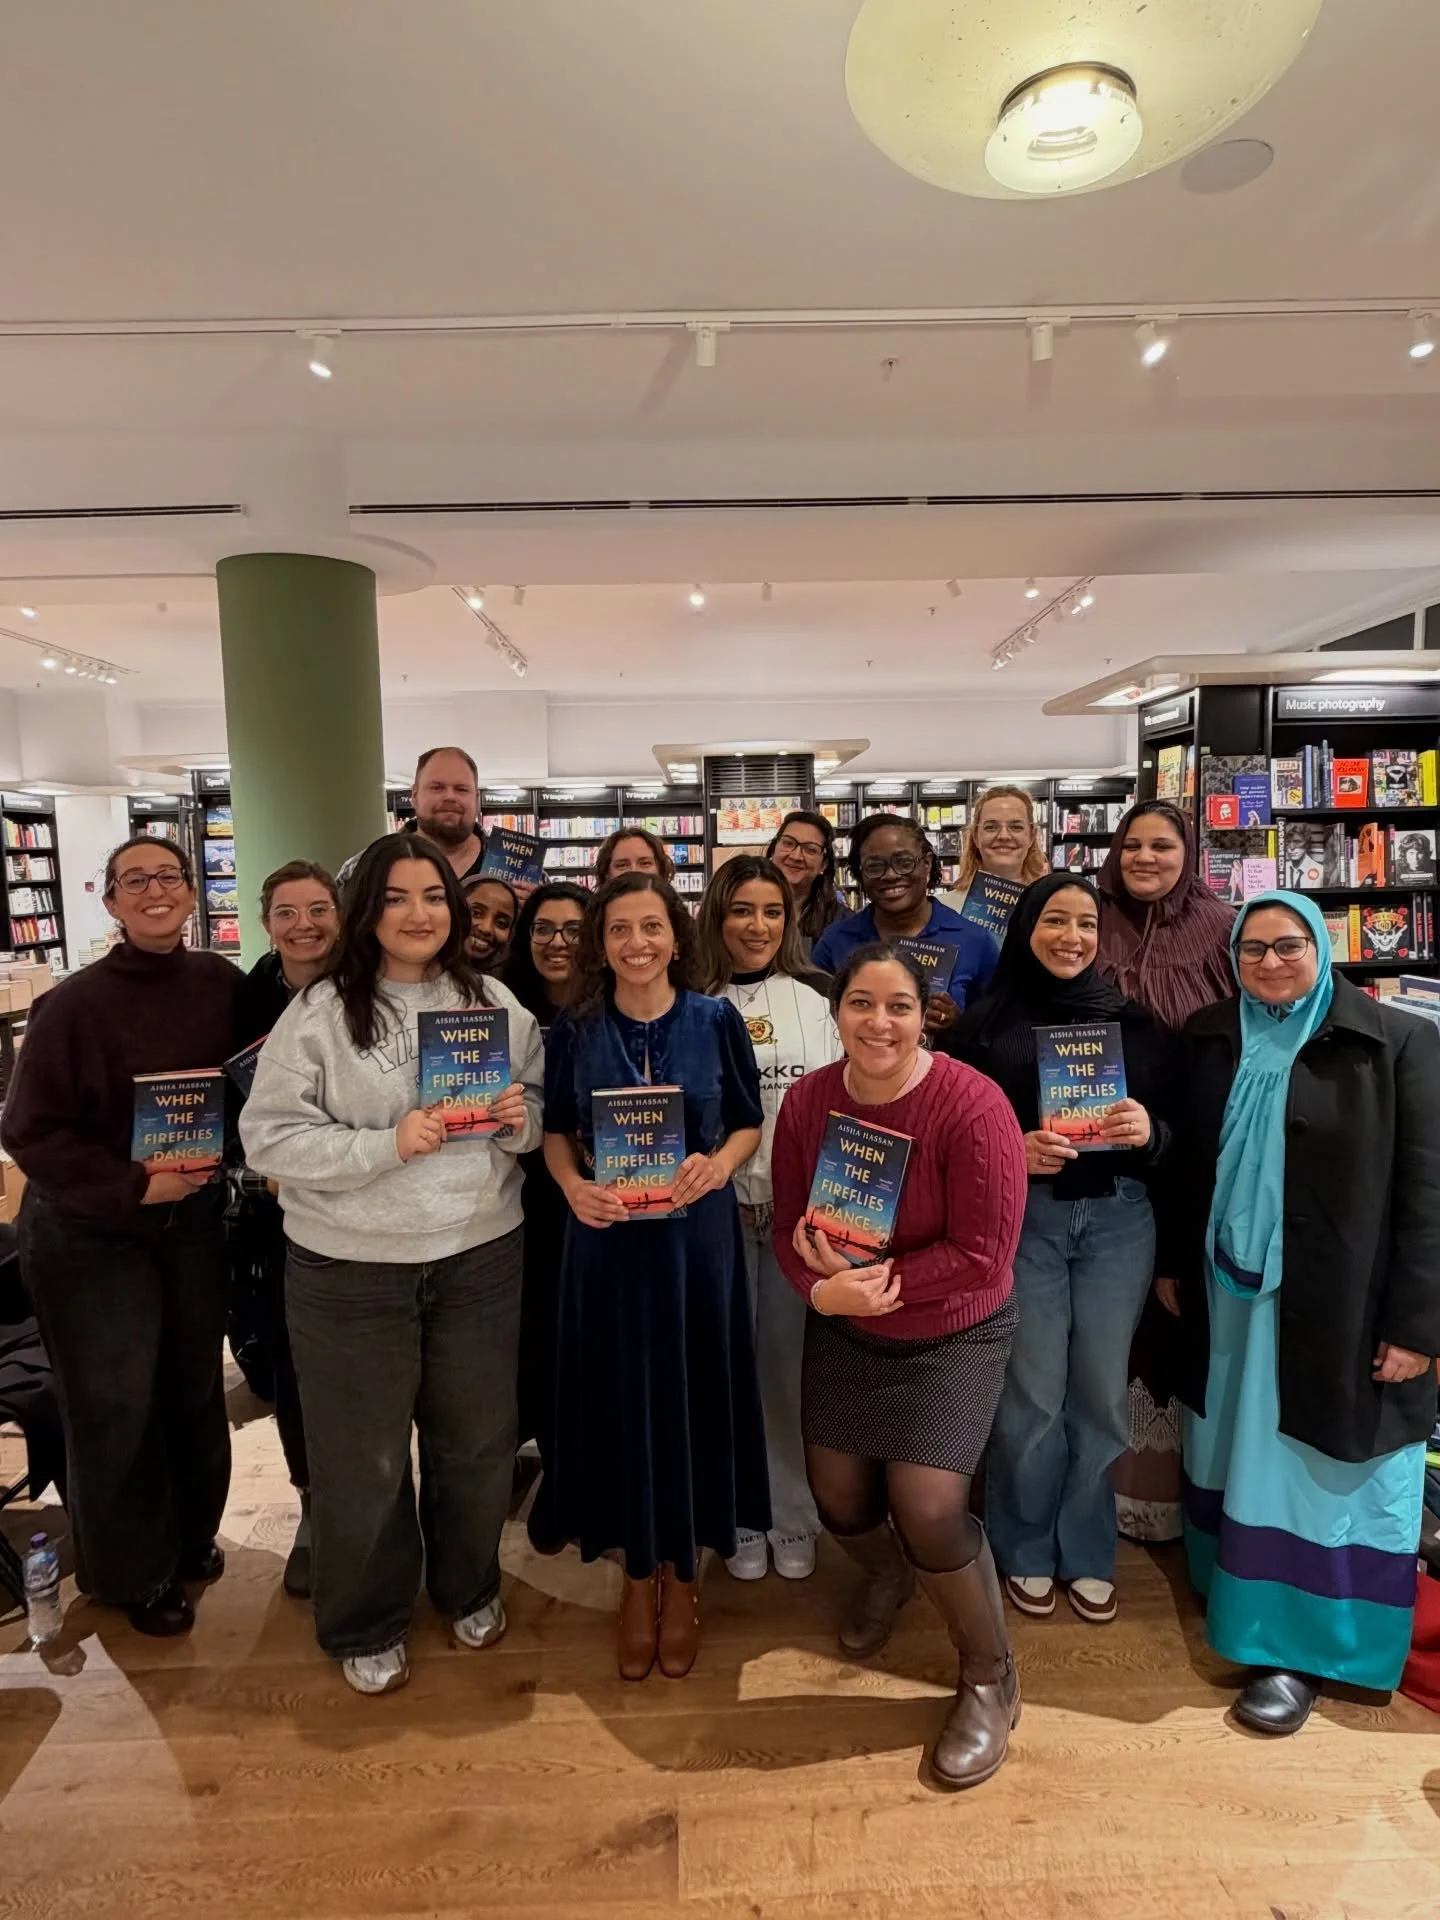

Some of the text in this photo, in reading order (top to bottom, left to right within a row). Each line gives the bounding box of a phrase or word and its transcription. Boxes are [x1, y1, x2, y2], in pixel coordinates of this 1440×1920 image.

[1286, 698, 1385, 712] Music photography
[502, 840, 533, 856] WHEN
[504, 856, 524, 868] THE
[984, 888, 1019, 906] WHEN
[986, 904, 1007, 919] THE
[910, 952, 938, 968] HEN
[463, 1015, 495, 1024] HASSAN
[440, 1028, 489, 1043] WHEN
[1050, 1029, 1107, 1039] AISHA HASSAN
[452, 1050, 480, 1064] THE
[1055, 1042, 1103, 1057] WHEN
[758, 1065, 804, 1078] KKO
[1066, 1063, 1095, 1078] THE
[432, 1070, 501, 1088] FIREFLIES
[1050, 1084, 1117, 1099] FIREFLIES
[155, 1093, 205, 1107] WHEN
[443, 1093, 492, 1109] DANCE
[165, 1112, 194, 1125] THE
[614, 1111, 664, 1126] WHEN
[144, 1128, 213, 1144] FIREFLIES
[625, 1132, 654, 1146] THE
[838, 1124, 894, 1147] AISHA HASSAN
[153, 1148, 204, 1161] DANCE
[840, 1138, 885, 1166] WHEN
[606, 1152, 676, 1169] FIREFLIES
[844, 1162, 871, 1184] THE
[616, 1174, 666, 1189] DANCE
[821, 1178, 884, 1212] FIREFLIES
[824, 1203, 871, 1230] DANCE
